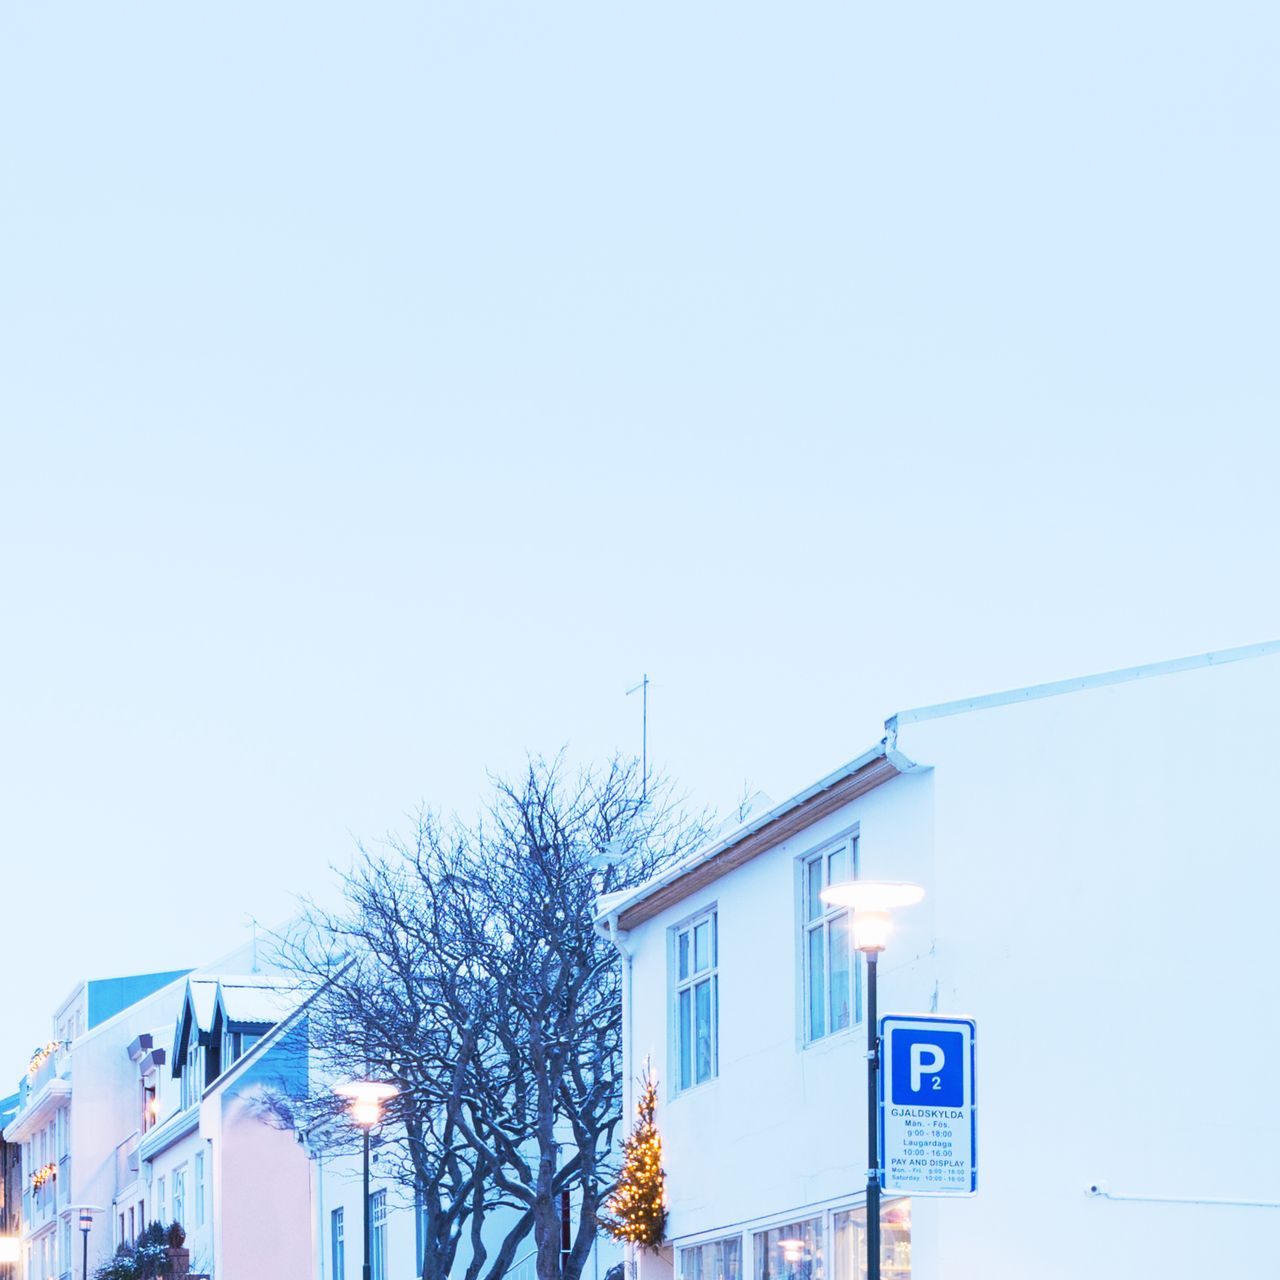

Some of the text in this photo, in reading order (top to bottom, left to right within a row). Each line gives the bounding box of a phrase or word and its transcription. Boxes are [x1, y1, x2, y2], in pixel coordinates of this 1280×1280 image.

[910, 1043, 945, 1092] P 2
[891, 1108, 964, 1119] GJALDSKYLDA
[931, 1130, 952, 1138] 18:00
[903, 1139, 952, 1149] Laugardaga
[904, 1149, 924, 1157] 10:00
[891, 1158, 907, 1166] PAY
[929, 1159, 965, 1168] DISPLAY
